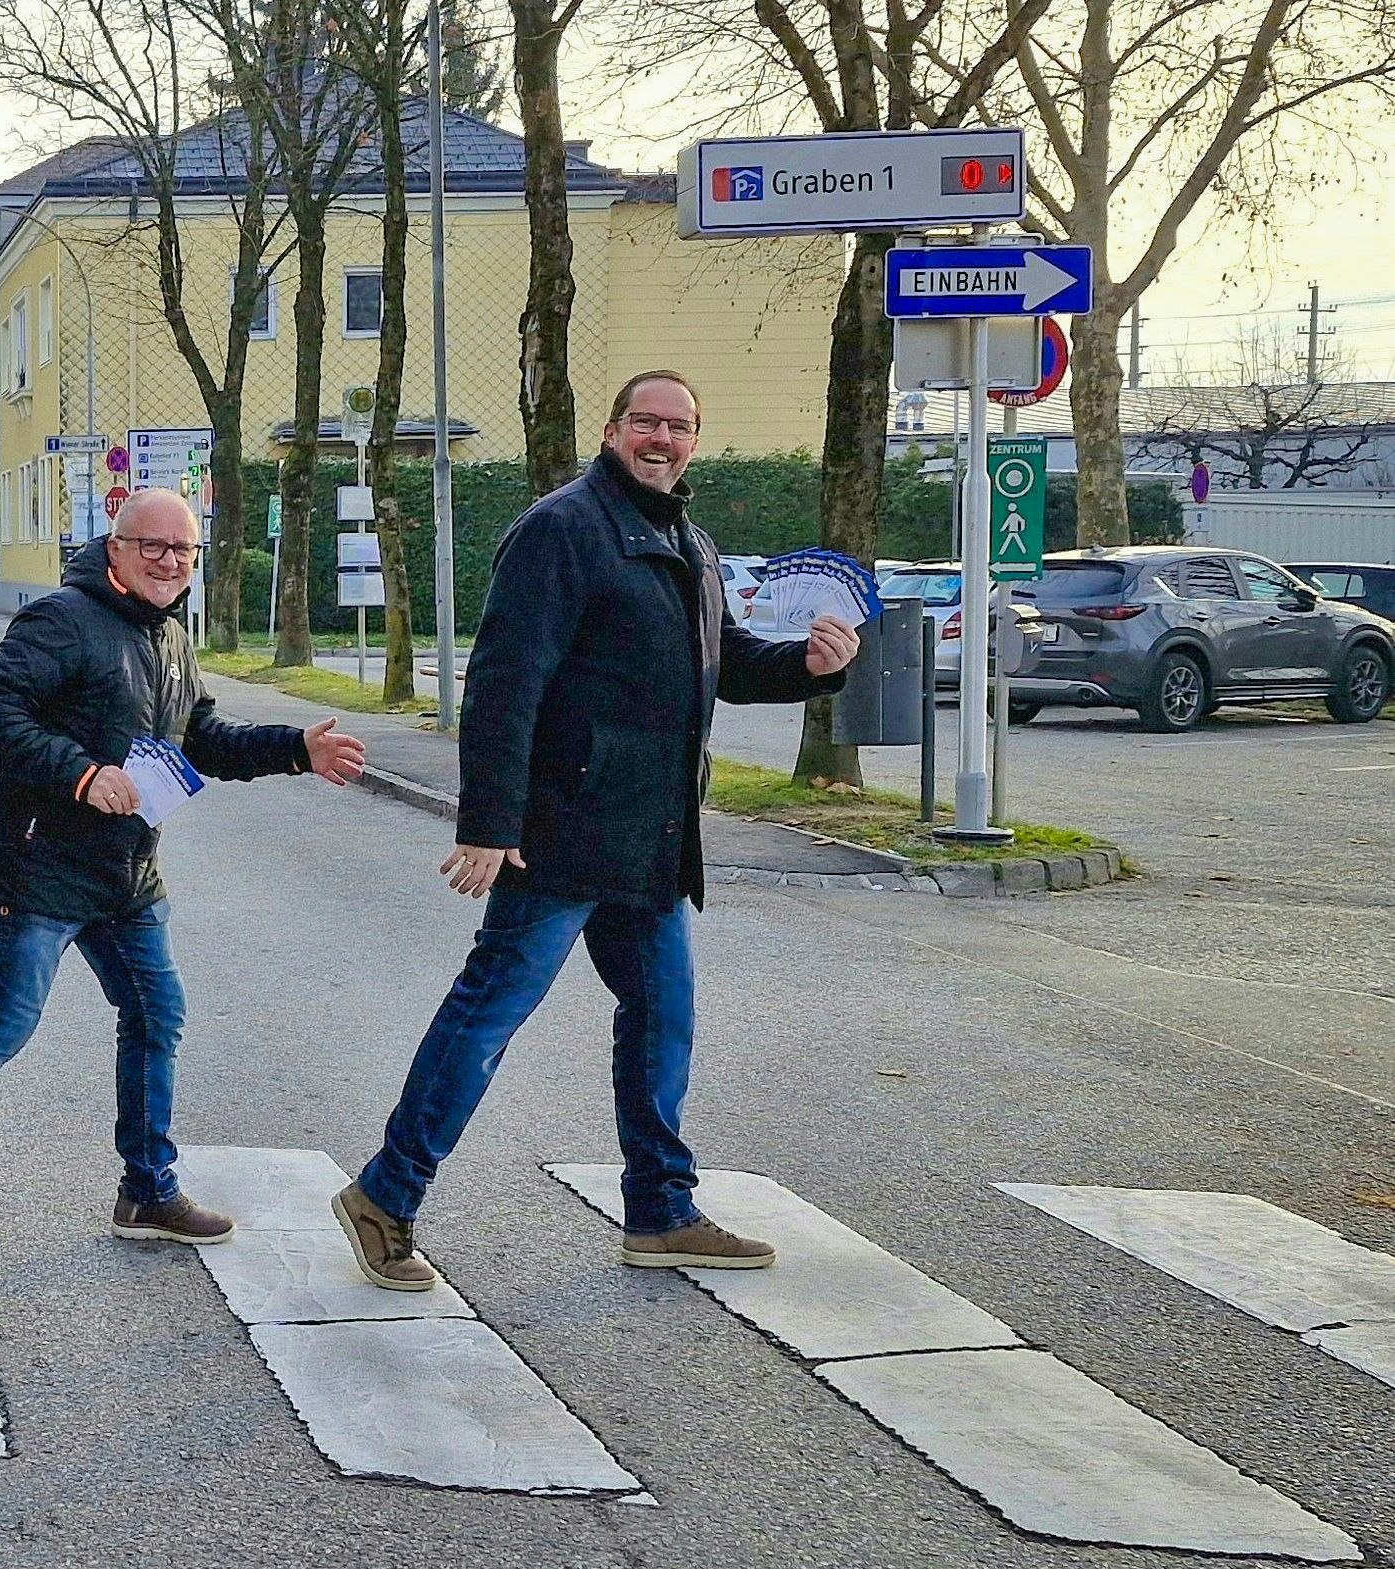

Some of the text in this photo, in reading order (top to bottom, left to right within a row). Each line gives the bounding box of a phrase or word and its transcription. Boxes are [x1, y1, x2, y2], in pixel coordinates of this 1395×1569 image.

[772, 169, 873, 195] Graben
[882, 165, 893, 190] 1
[961, 160, 982, 190] 0
[914, 271, 1017, 293] EINBAHN
[999, 391, 1037, 406] ANFANG
[989, 444, 1042, 455] ZENTRUM
[107, 497, 125, 512] STO
